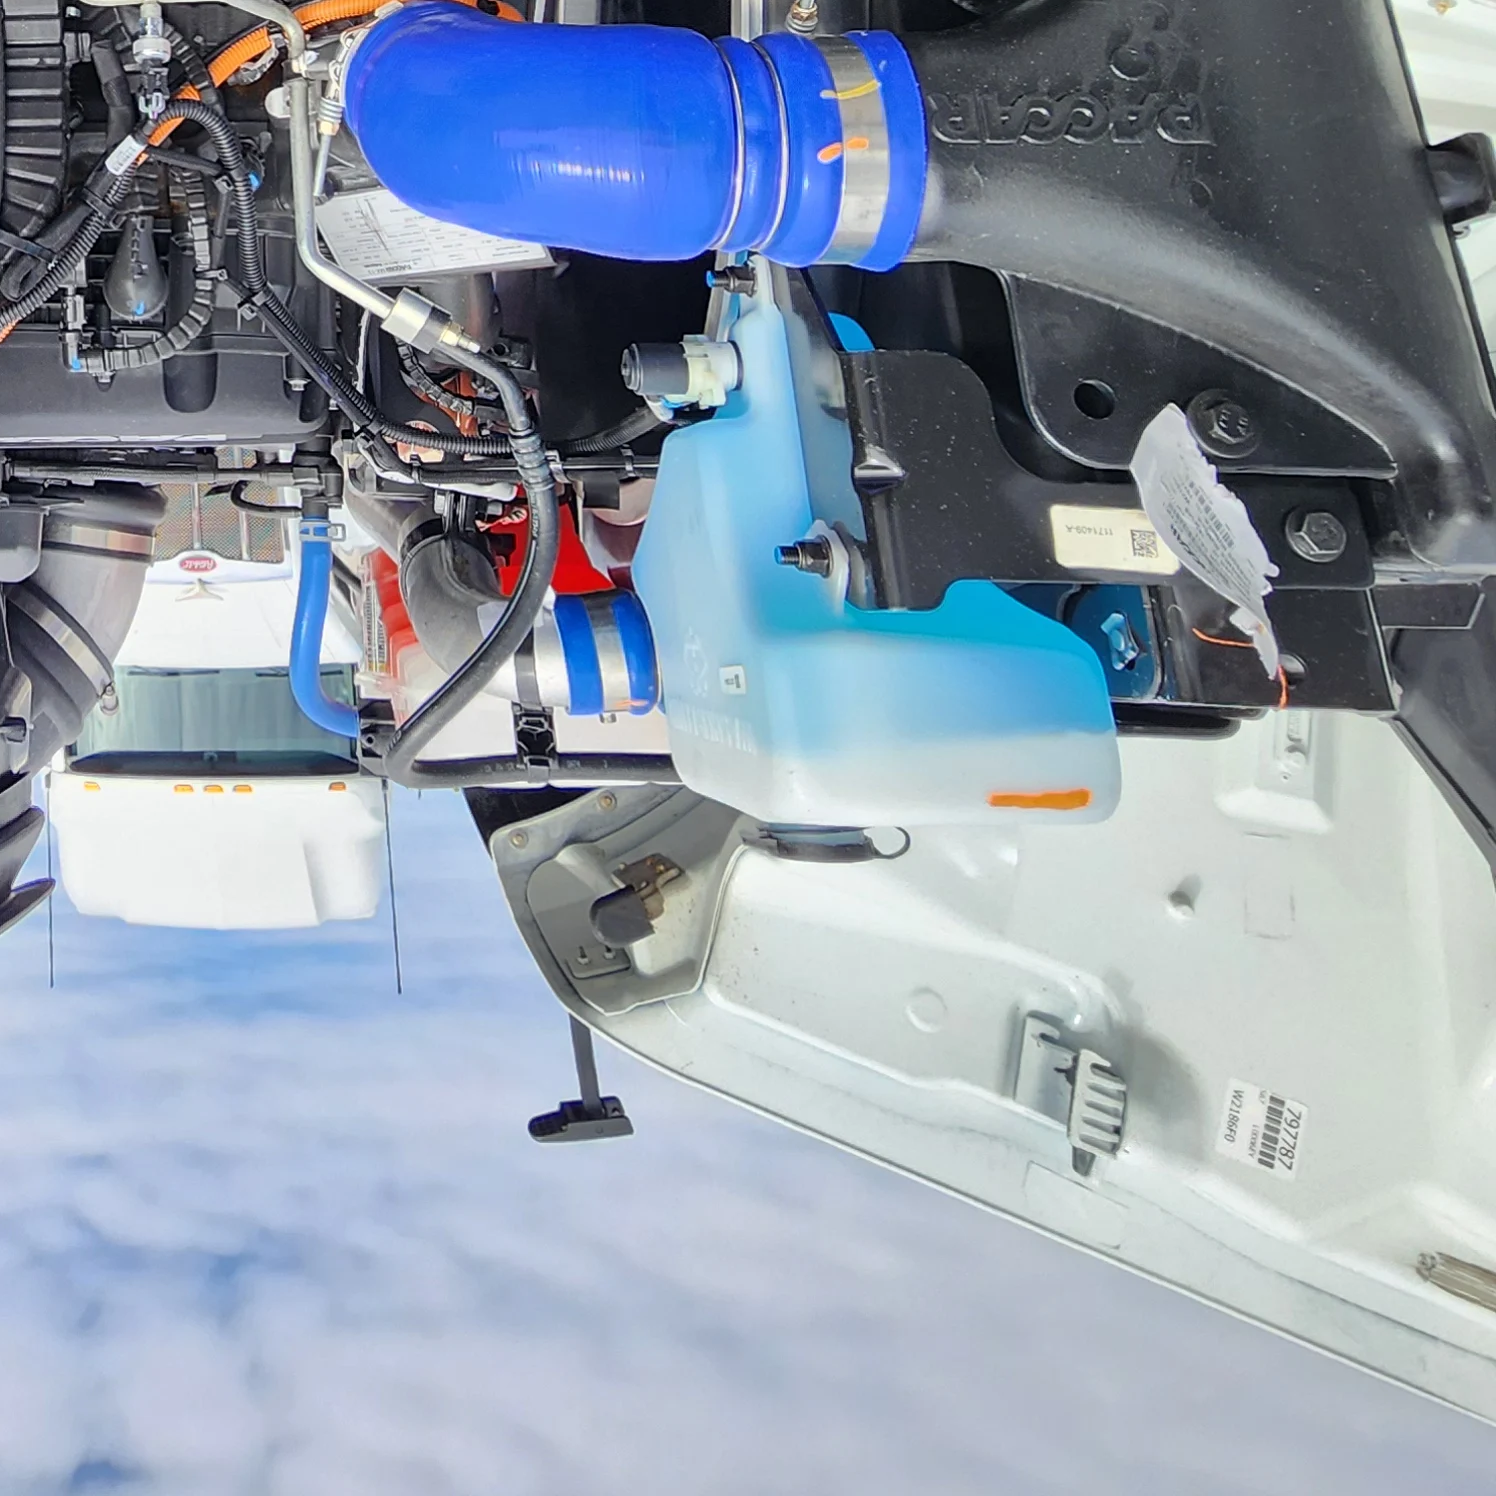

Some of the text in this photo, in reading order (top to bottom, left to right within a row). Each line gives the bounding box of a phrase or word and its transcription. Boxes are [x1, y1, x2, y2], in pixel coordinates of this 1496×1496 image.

[926, 94, 1211, 145] PACCAR
[1064, 524, 1114, 536] 1171409-A
[1278, 1108, 1302, 1171] 797787
